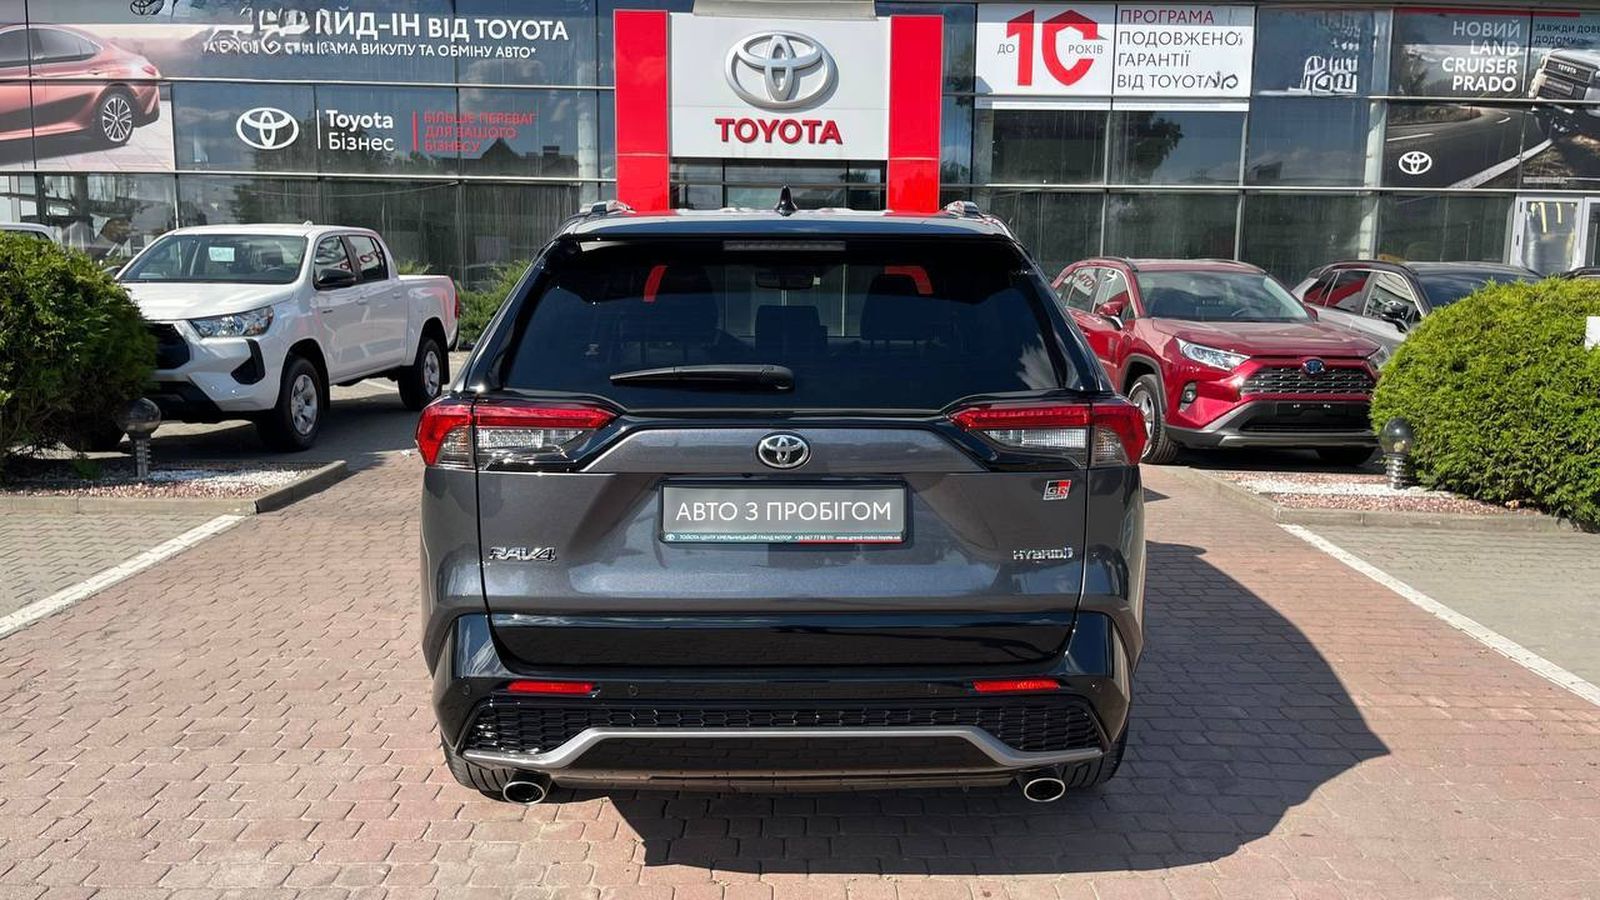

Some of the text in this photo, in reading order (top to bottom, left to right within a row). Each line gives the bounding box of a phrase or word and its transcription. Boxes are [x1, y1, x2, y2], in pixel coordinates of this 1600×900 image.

[1120, 9, 1215, 24] ПРОГРАМА
[428, 18, 470, 42] ВІД
[475, 19, 569, 41] TOYOTA
[1452, 19, 1520, 38] НОВИЙ
[361, 43, 416, 57] ВИКУПУ
[419, 44, 435, 57] ТА
[438, 45, 492, 58] ОБМІНУ
[997, 43, 1015, 55] ДО
[1068, 44, 1104, 55] РОКІВ
[1470, 39, 1520, 56] LAND
[1118, 50, 1191, 67] ГАРАНТІЇ
[1441, 56, 1518, 75] CRUISER
[1117, 74, 1144, 90] ВІД
[1452, 75, 1517, 93] PRADO
[326, 109, 394, 132] Toyota
[715, 118, 843, 144] TOYOTA
[328, 132, 394, 152] Бізнес
[675, 502, 738, 521] АВТО
[767, 502, 892, 521] ПРОБІГОМ
[489, 546, 557, 562] RAV4
[1013, 549, 1064, 560] HYBRID
